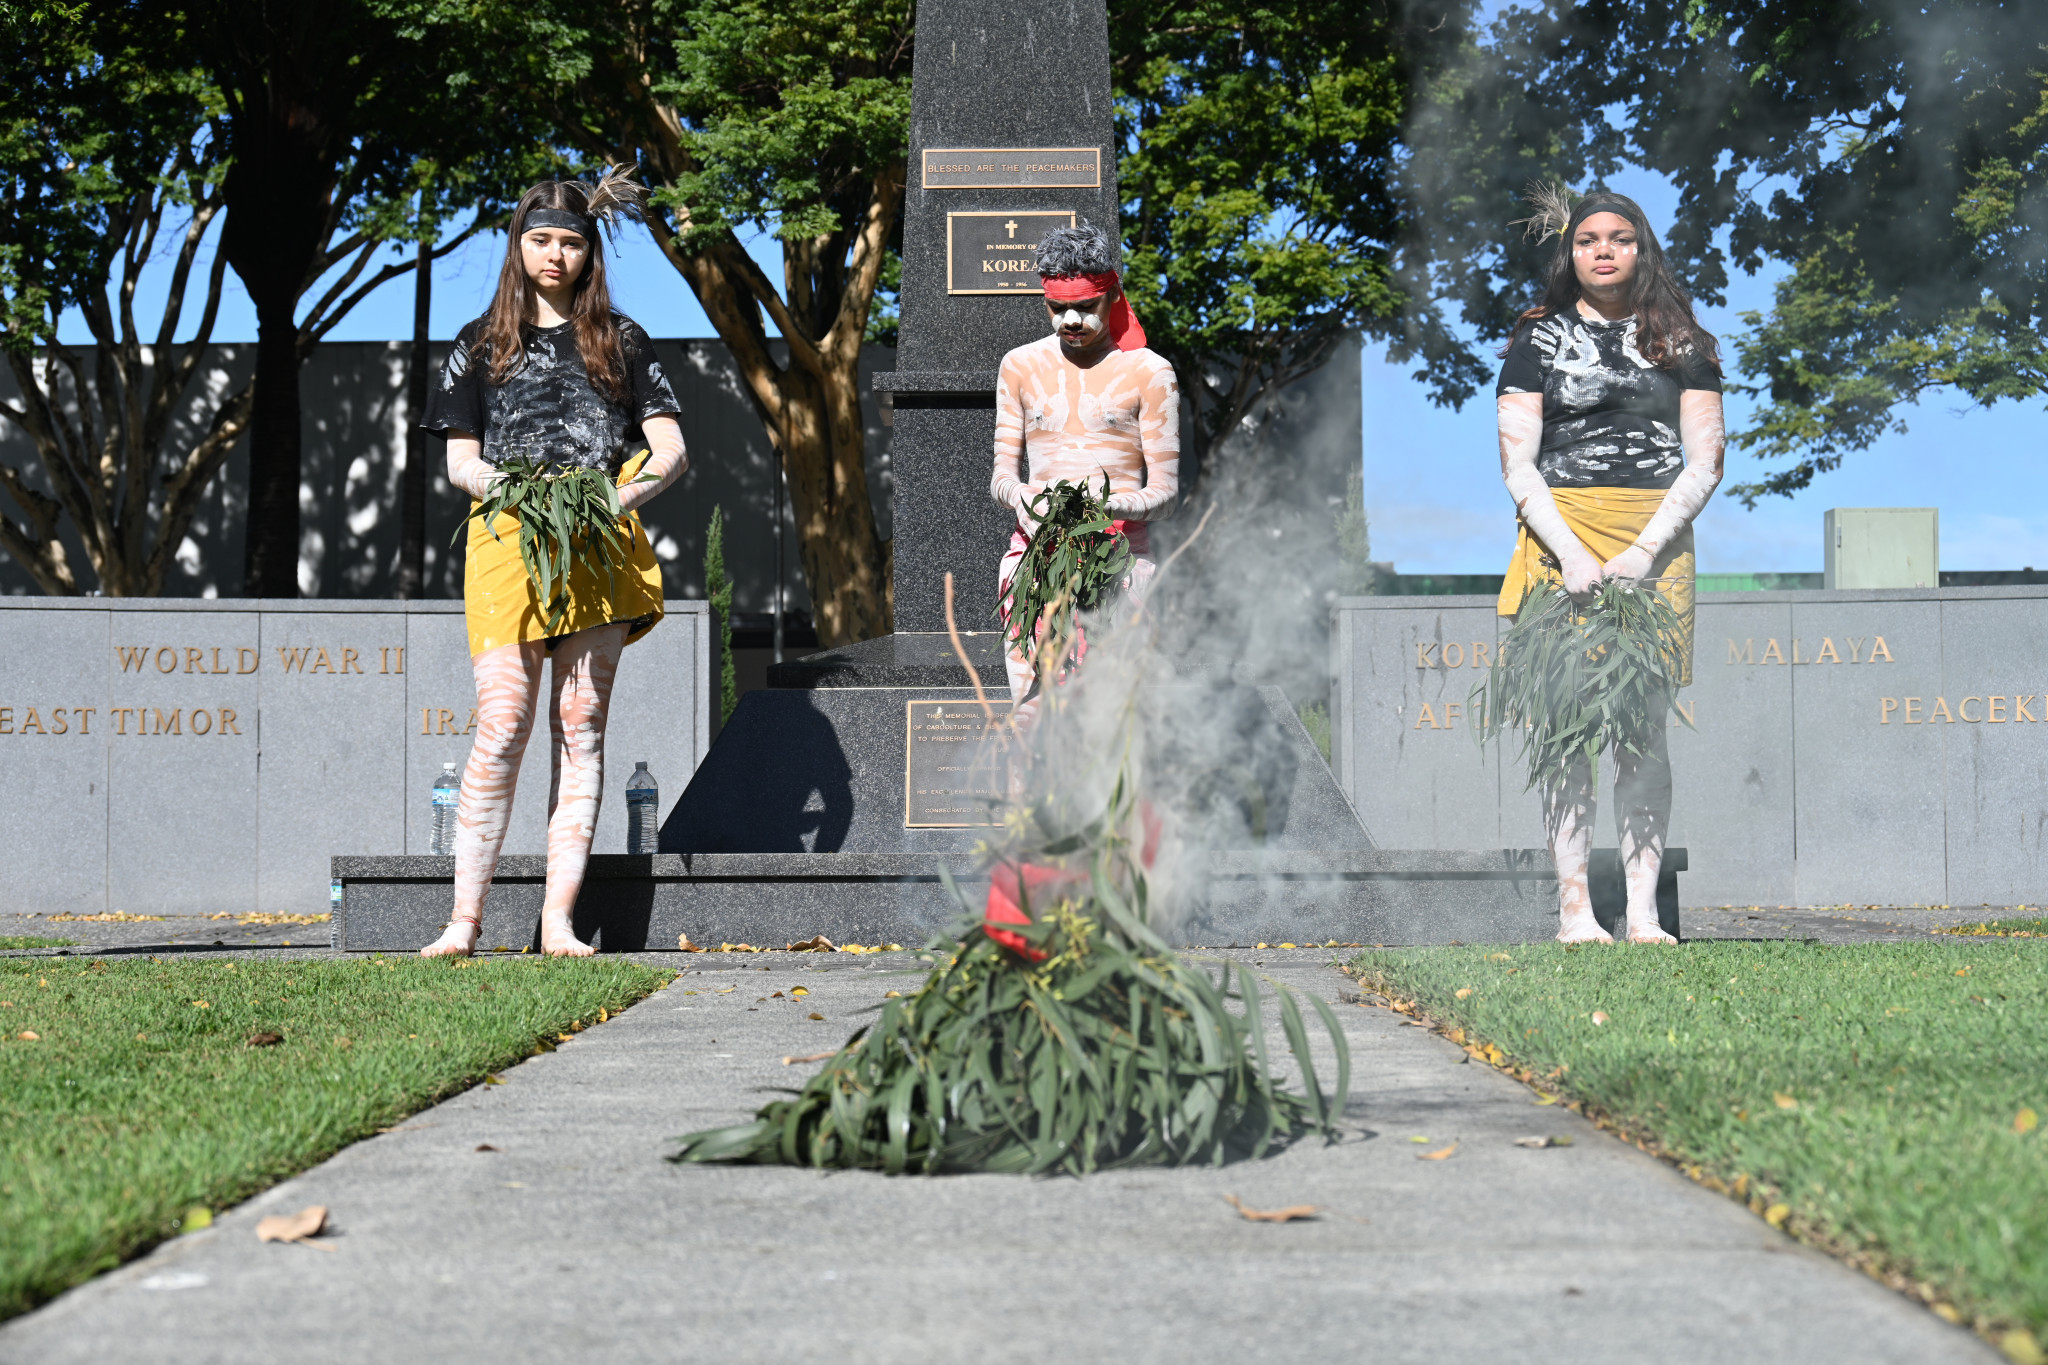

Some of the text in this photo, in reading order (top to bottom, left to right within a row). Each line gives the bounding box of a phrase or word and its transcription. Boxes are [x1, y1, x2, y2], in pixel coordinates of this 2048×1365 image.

[928, 165, 970, 173] BLESSED
[1001, 164, 1020, 172] THE
[1026, 164, 1095, 172] PEACEMAKERS
[982, 260, 1039, 272] KOREA
[114, 645, 404, 674] WORLD WAR II
[1726, 636, 1895, 665] MALAYA
[0, 707, 242, 735] EAST TIMOR
[1880, 695, 2048, 725] PEACEK
